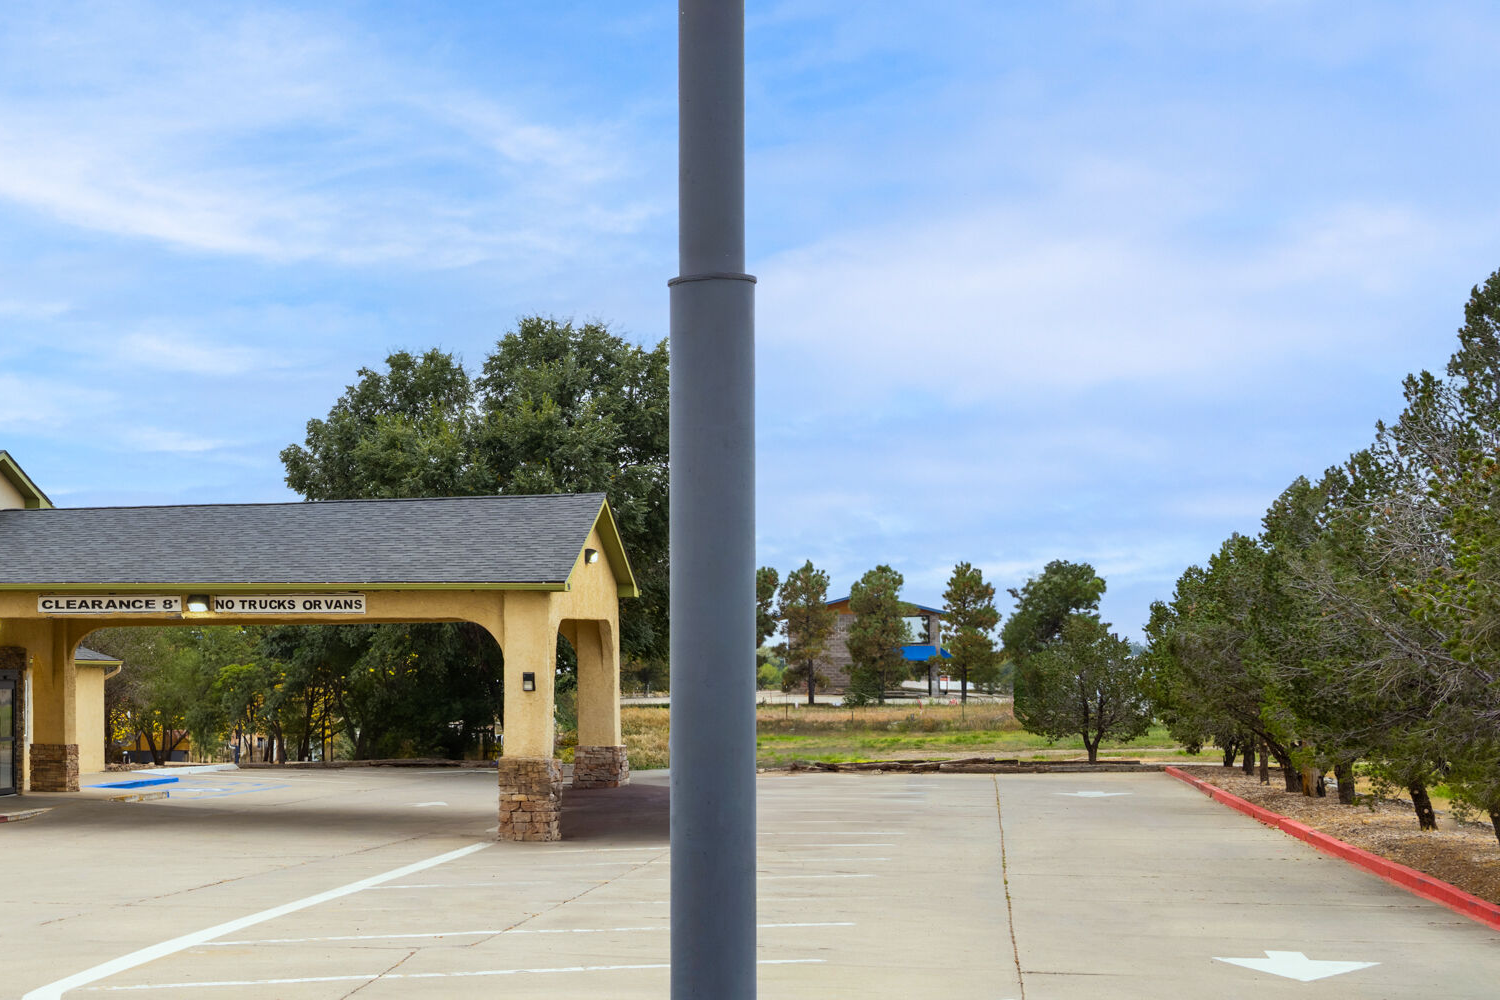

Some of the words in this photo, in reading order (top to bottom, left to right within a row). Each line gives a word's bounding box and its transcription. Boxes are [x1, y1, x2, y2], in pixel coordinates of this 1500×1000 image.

[41, 599, 156, 610] CLEARANCE
[215, 599, 235, 610] NO
[239, 599, 296, 610] TRUCKS
[302, 599, 322, 610] OR
[323, 599, 363, 610] VANS
